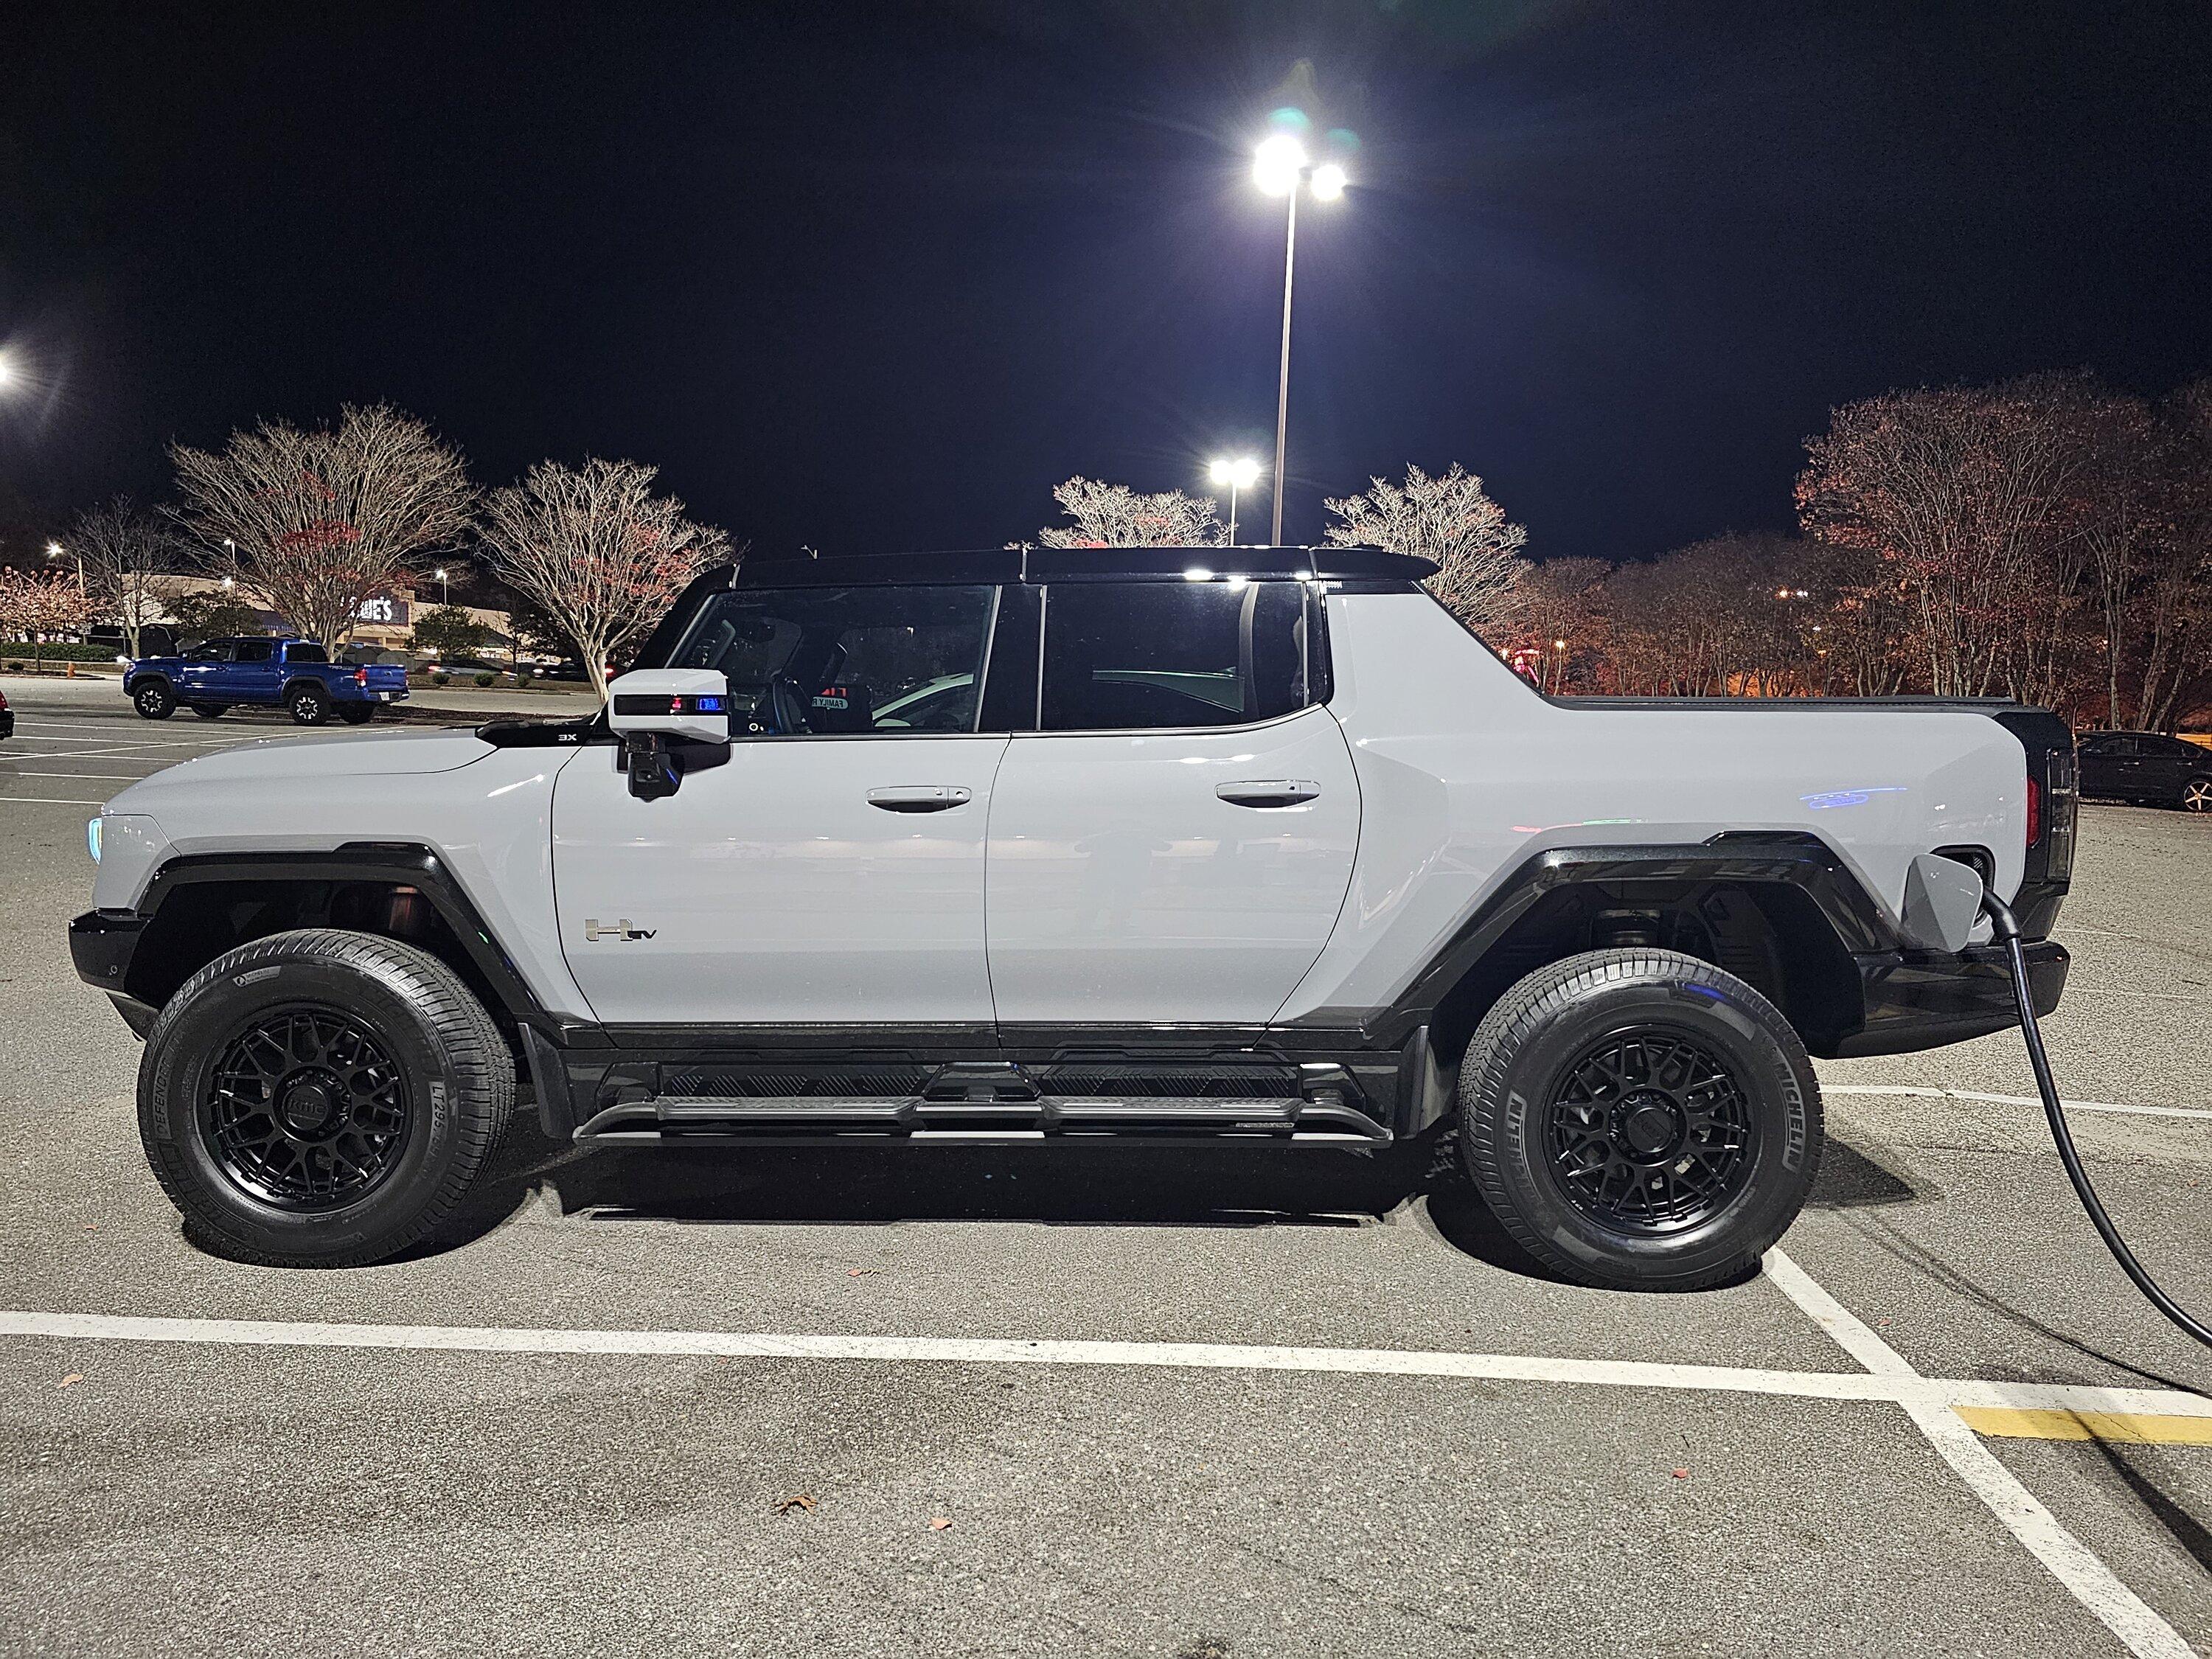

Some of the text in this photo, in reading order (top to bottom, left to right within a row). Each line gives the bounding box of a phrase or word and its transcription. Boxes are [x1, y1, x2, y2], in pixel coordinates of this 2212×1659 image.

[340, 596, 393, 622] WE'S
[557, 733, 577, 741] 3X
[1773, 1061, 1803, 1167] MICHELIN
